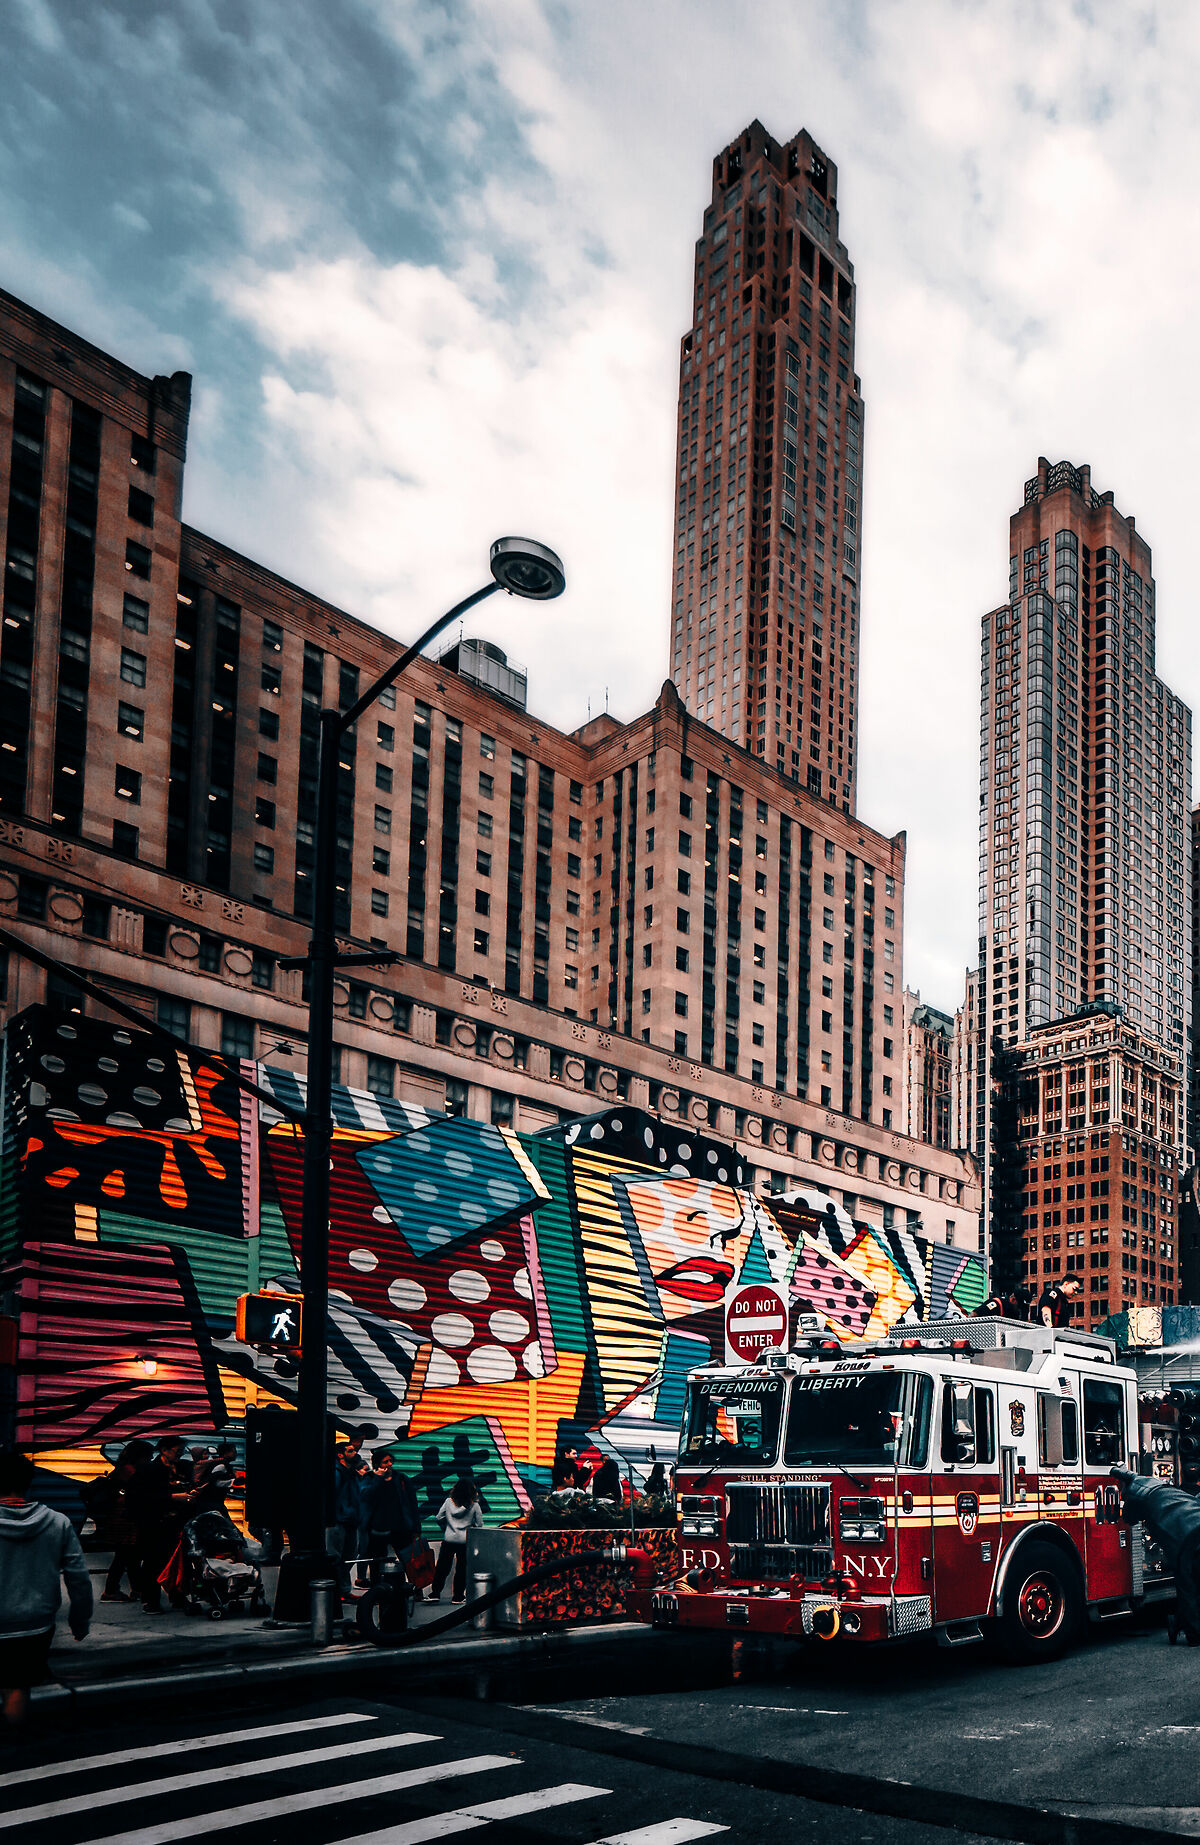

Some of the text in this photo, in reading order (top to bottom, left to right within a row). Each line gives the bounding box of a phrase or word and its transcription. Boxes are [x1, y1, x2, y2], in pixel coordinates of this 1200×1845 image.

[735, 1299, 777, 1313] DO NOT
[739, 1334, 774, 1347] ENTER
[740, 1361, 872, 1377] Ten House
[700, 1376, 866, 1395] DEFENDING LIBERTY
